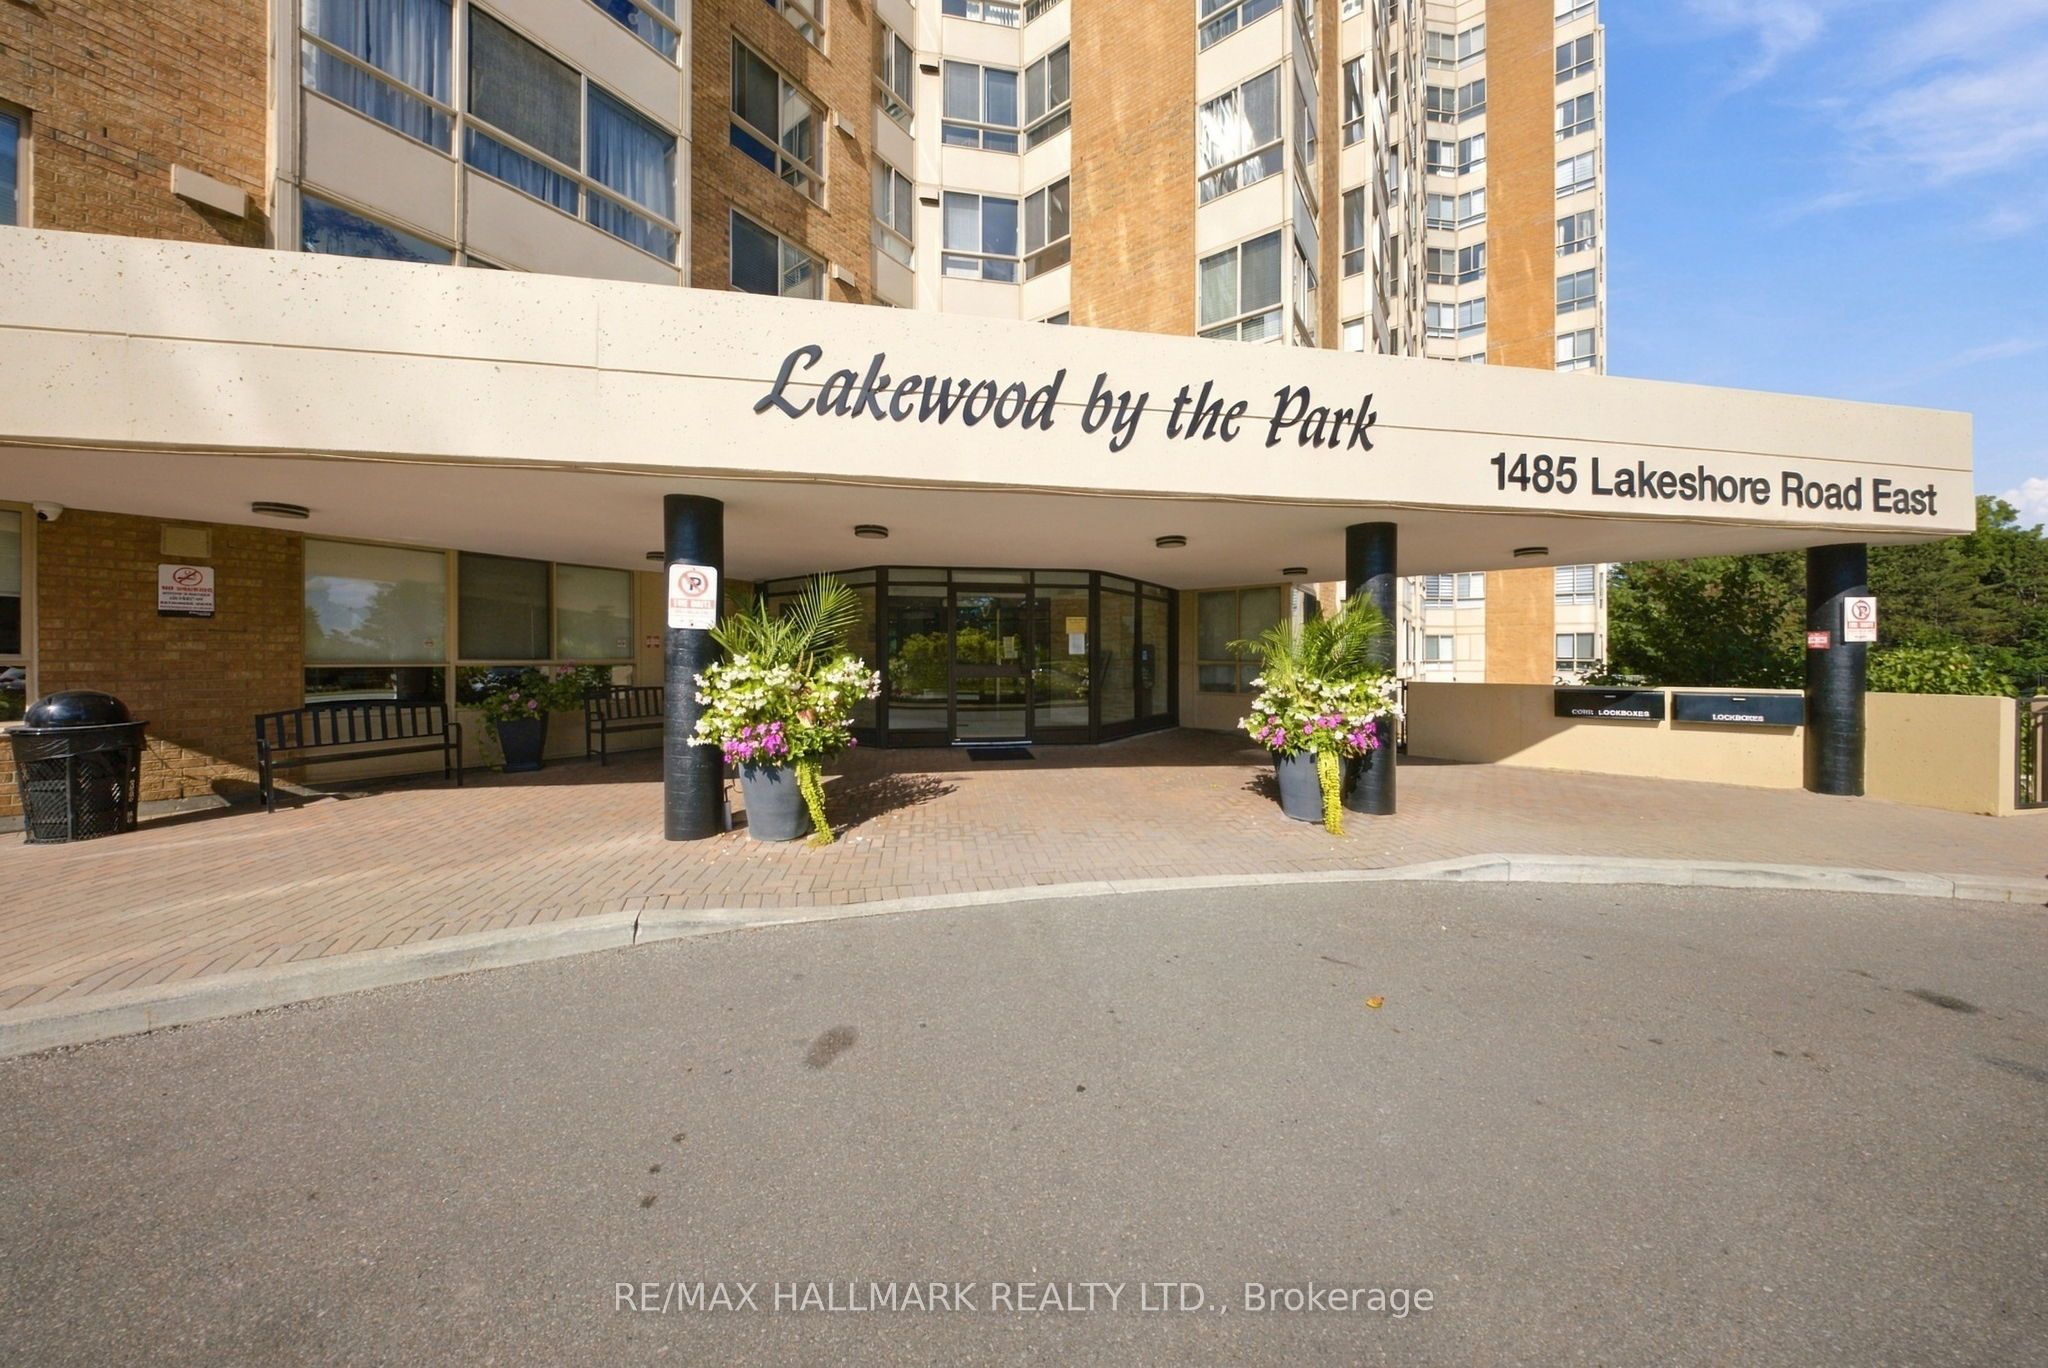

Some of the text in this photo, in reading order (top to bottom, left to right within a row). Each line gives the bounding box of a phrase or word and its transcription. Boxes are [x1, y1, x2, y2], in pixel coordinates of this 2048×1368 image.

[753, 344, 1378, 453] Lakewood by the Park
[1490, 452, 1938, 516] 1485 Lakeshore Road East
[1598, 709, 1650, 718] LOCKBOXES
[1712, 713, 1764, 722] LOCKBOXES
